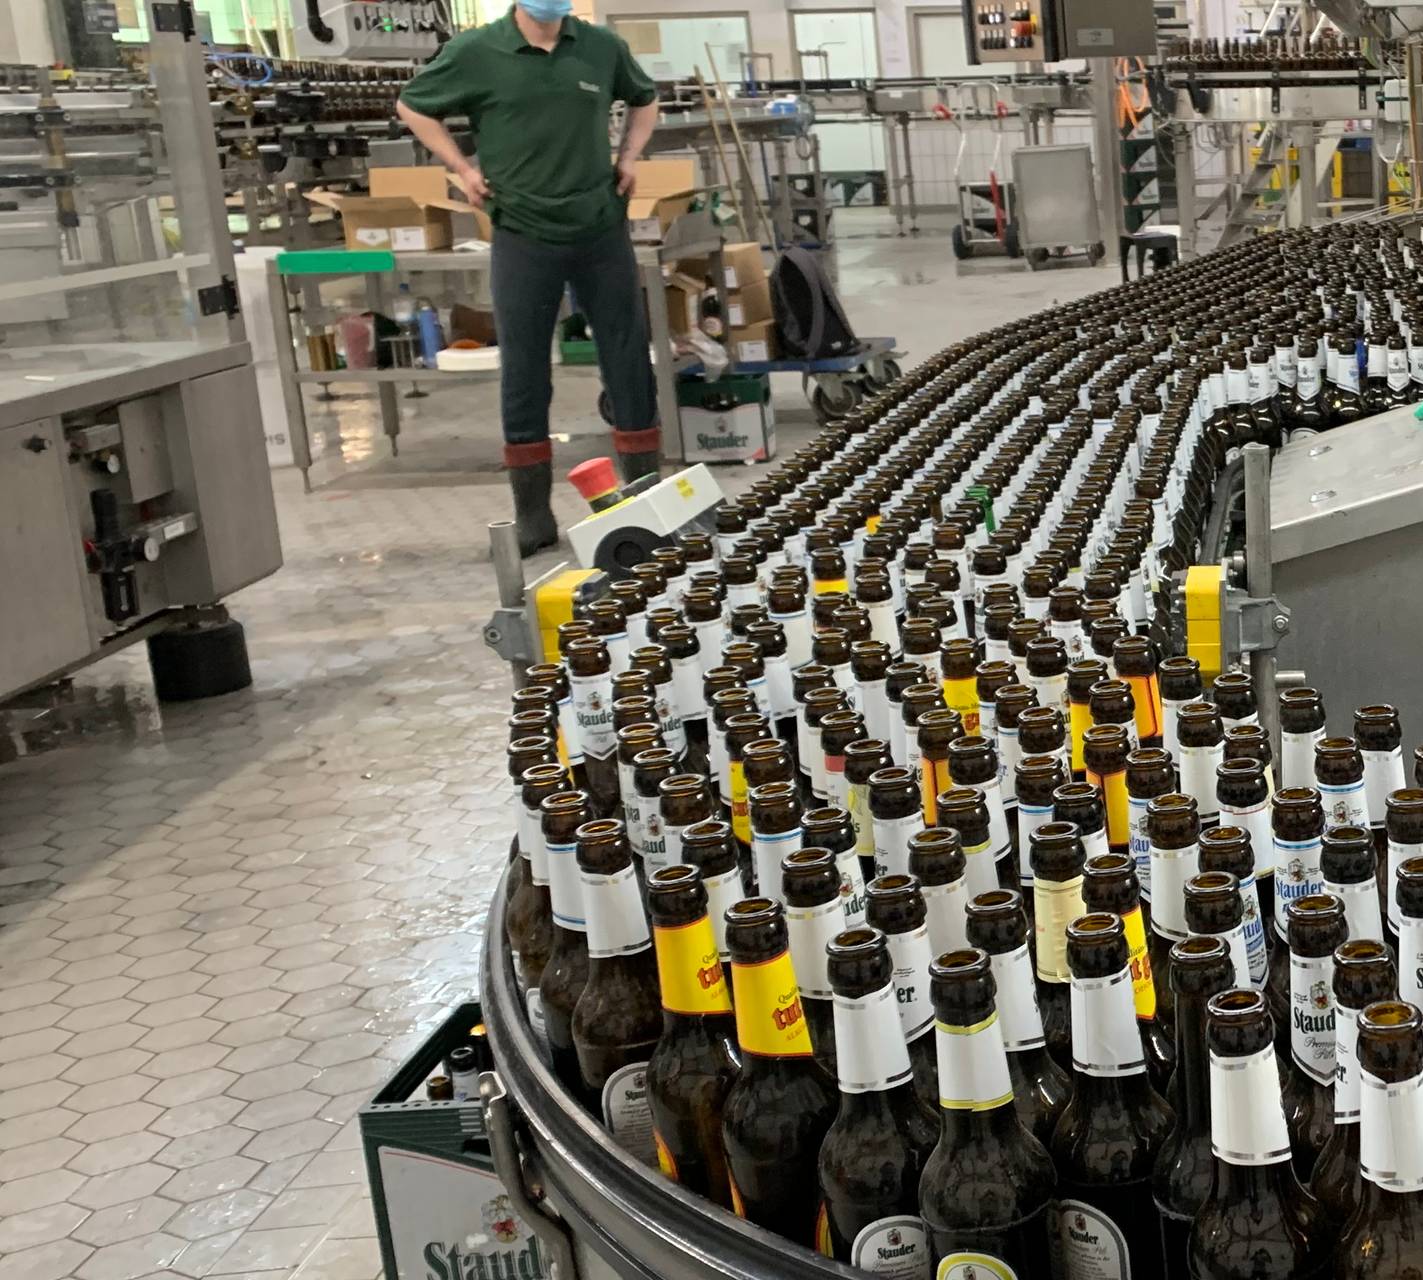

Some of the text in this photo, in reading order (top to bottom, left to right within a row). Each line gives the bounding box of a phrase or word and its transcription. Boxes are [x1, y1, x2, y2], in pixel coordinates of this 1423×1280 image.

[696, 432, 749, 451] Stauder
[1293, 1007, 1336, 1035] Staud
[877, 1244, 917, 1261] Stauder
